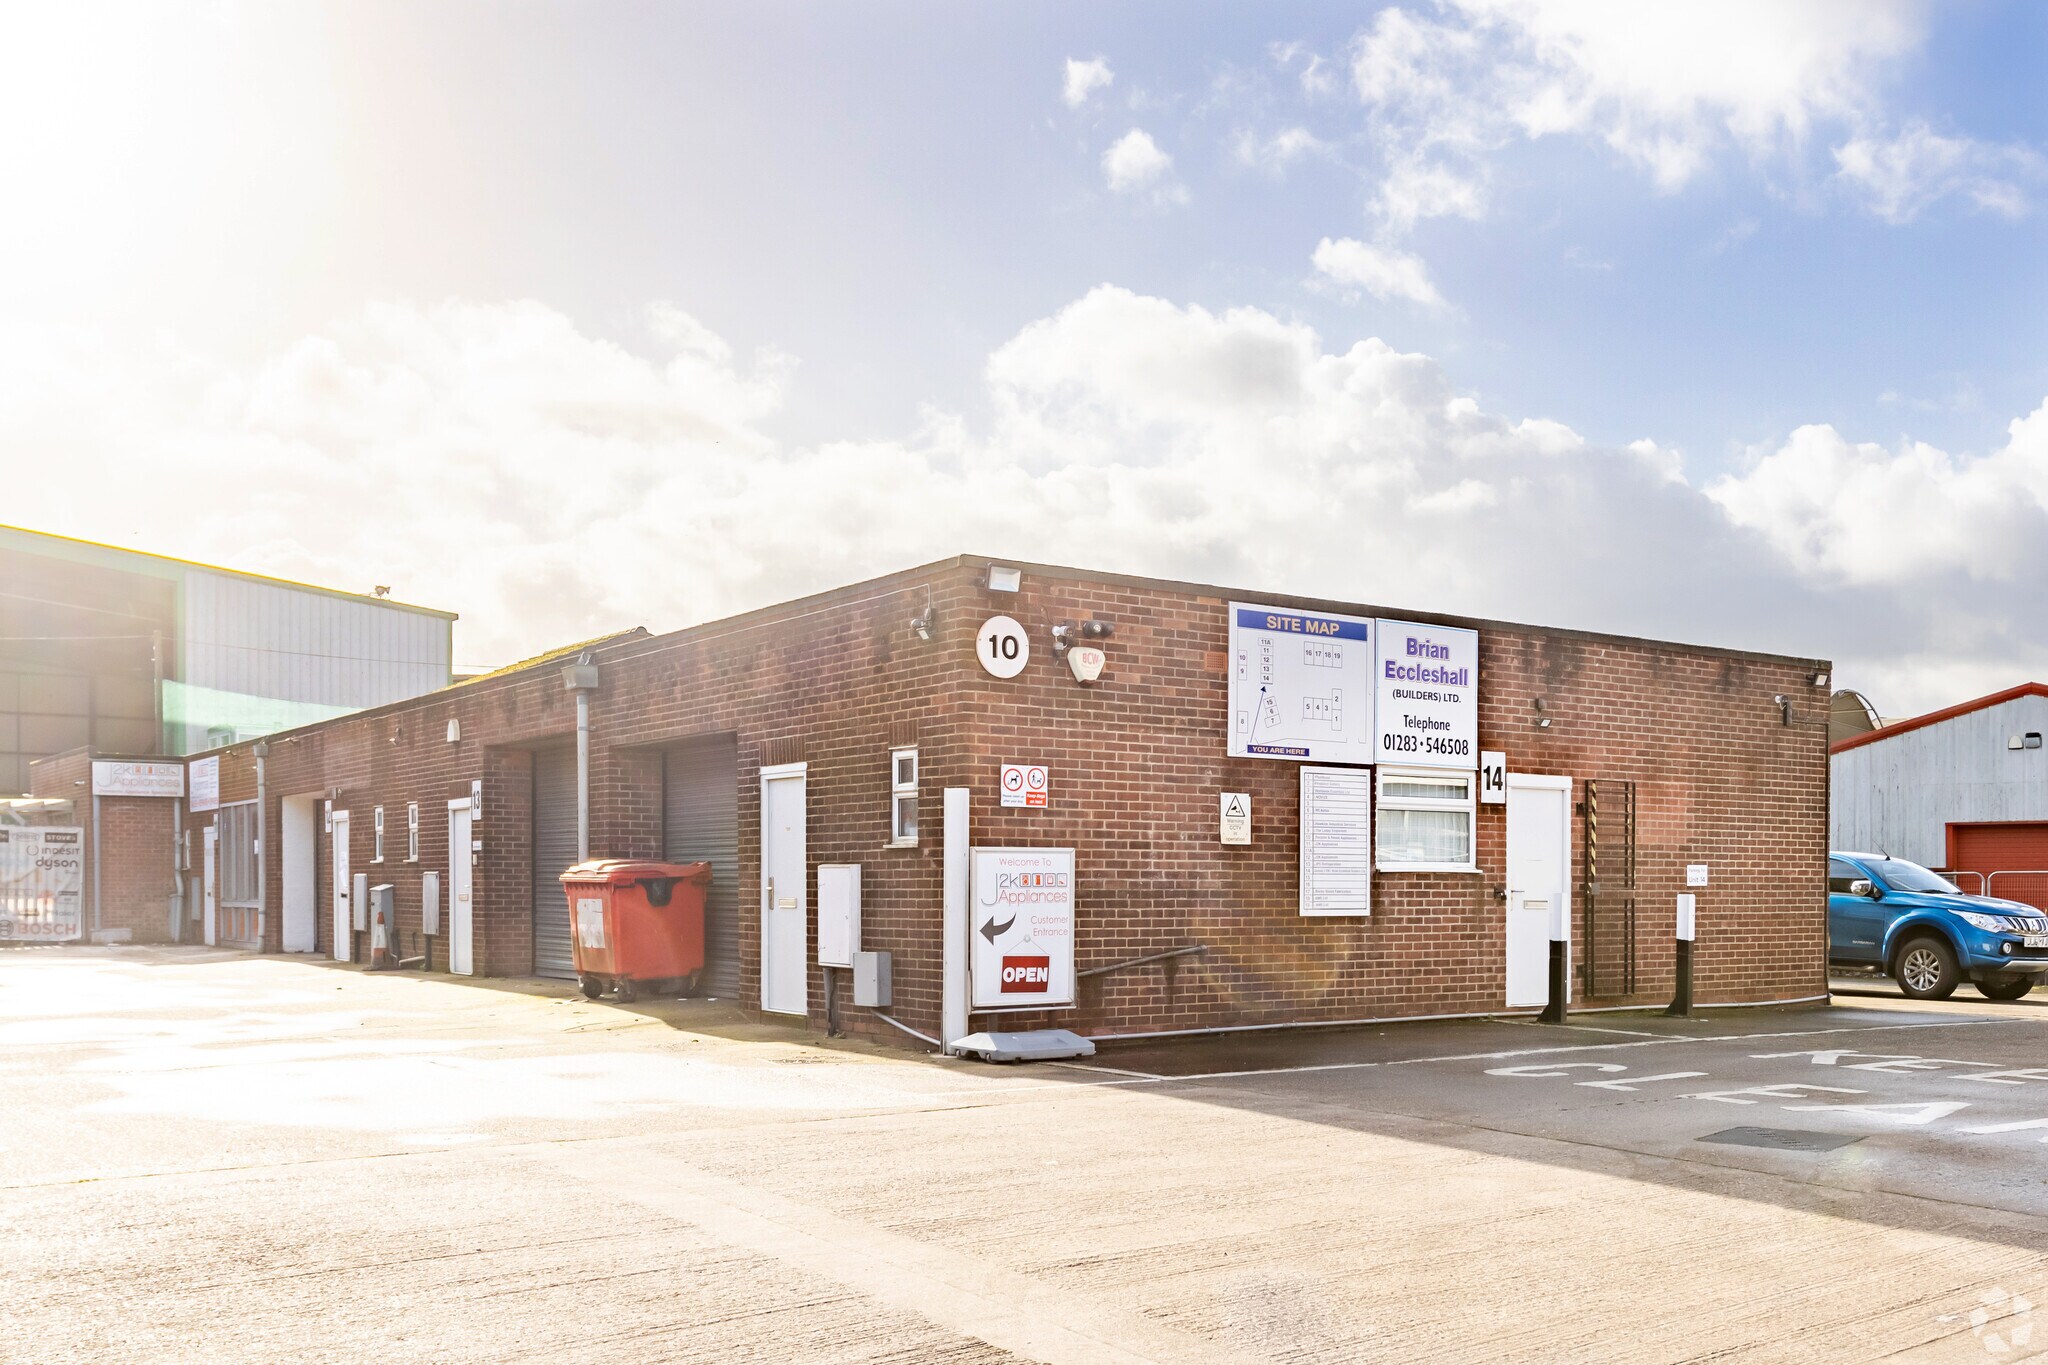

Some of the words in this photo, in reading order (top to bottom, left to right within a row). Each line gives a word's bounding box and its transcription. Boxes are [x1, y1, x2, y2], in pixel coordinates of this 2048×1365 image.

[1266, 615, 1301, 632] SITE
[1305, 619, 1340, 636] MAP
[989, 634, 1019, 660] 10
[1406, 637, 1449, 660] Brian
[1385, 660, 1468, 686] Eccleshall
[1393, 689, 1441, 702] (BUILDERS)
[1443, 693, 1461, 703] LTD.
[1404, 715, 1450, 732] Telephone
[1253, 746, 1267, 754] YOU
[1285, 748, 1305, 756] HERE
[1484, 765, 1503, 791] 14
[473, 790, 480, 810] 13
[36, 856, 78, 870] dyson
[999, 857, 1039, 866] Welcome
[1042, 857, 1052, 866] To
[998, 890, 1068, 906] Appliances
[1031, 916, 1068, 925] Customer
[18, 924, 76, 935] BOSCH
[1033, 928, 1068, 936] Entrance
[1003, 967, 1048, 983] OPEN
[1748, 1048, 2048, 1085] KEE
